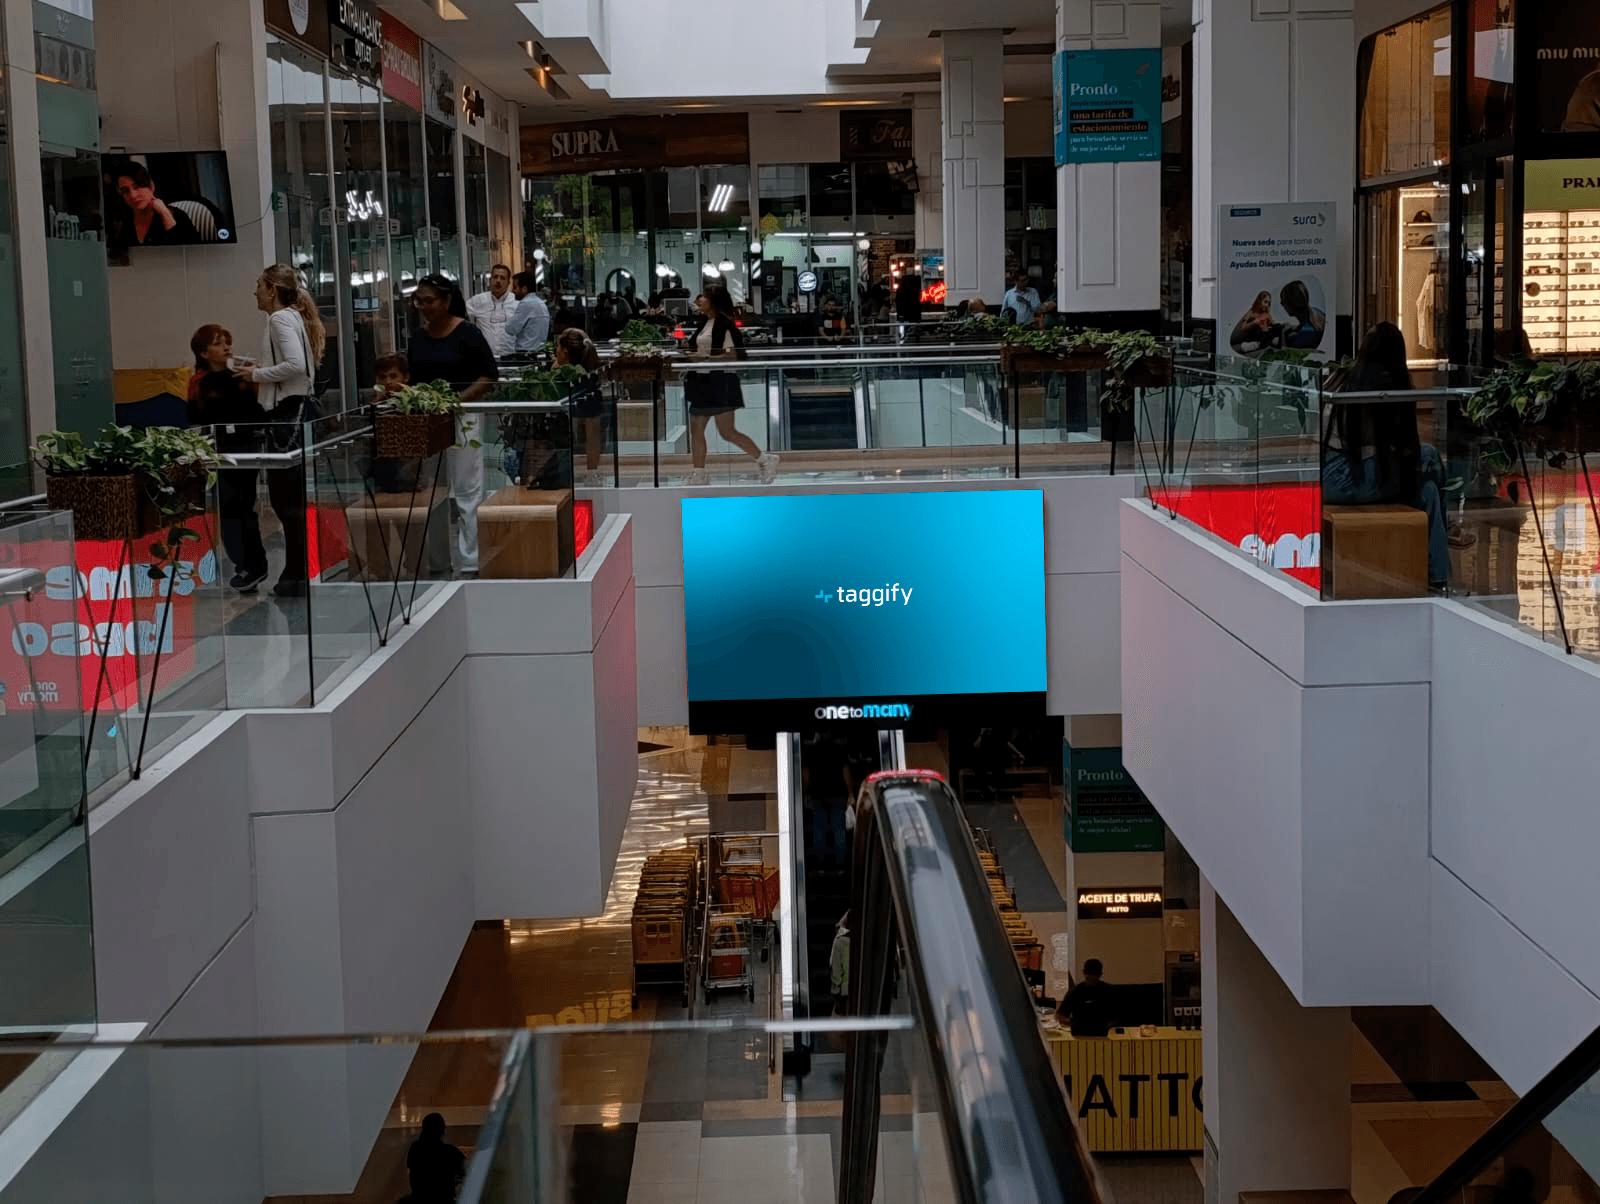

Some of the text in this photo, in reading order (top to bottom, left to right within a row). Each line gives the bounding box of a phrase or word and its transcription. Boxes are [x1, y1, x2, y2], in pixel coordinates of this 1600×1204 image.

[354, 37, 372, 64] OUTLET
[1069, 82, 1118, 97] Pronto
[1091, 109, 1117, 119] tarifa
[1118, 109, 1131, 118] de
[1072, 122, 1147, 133] estacionamiento
[551, 127, 621, 158] SUPRA
[1292, 215, 1317, 226] sura
[1232, 239, 1256, 247] Nueva
[1257, 238, 1275, 247] sede
[1277, 239, 1292, 247] para
[1313, 237, 1323, 245] de
[1235, 250, 1268, 258] muestras
[1269, 248, 1279, 256] de
[1230, 258, 1327, 270] Ayudas Diagnósticas SURA
[836, 583, 913, 606] taggify
[1077, 768, 1124, 781] Pronto
[1079, 892, 1162, 904] ACEITE DE TRUFA
